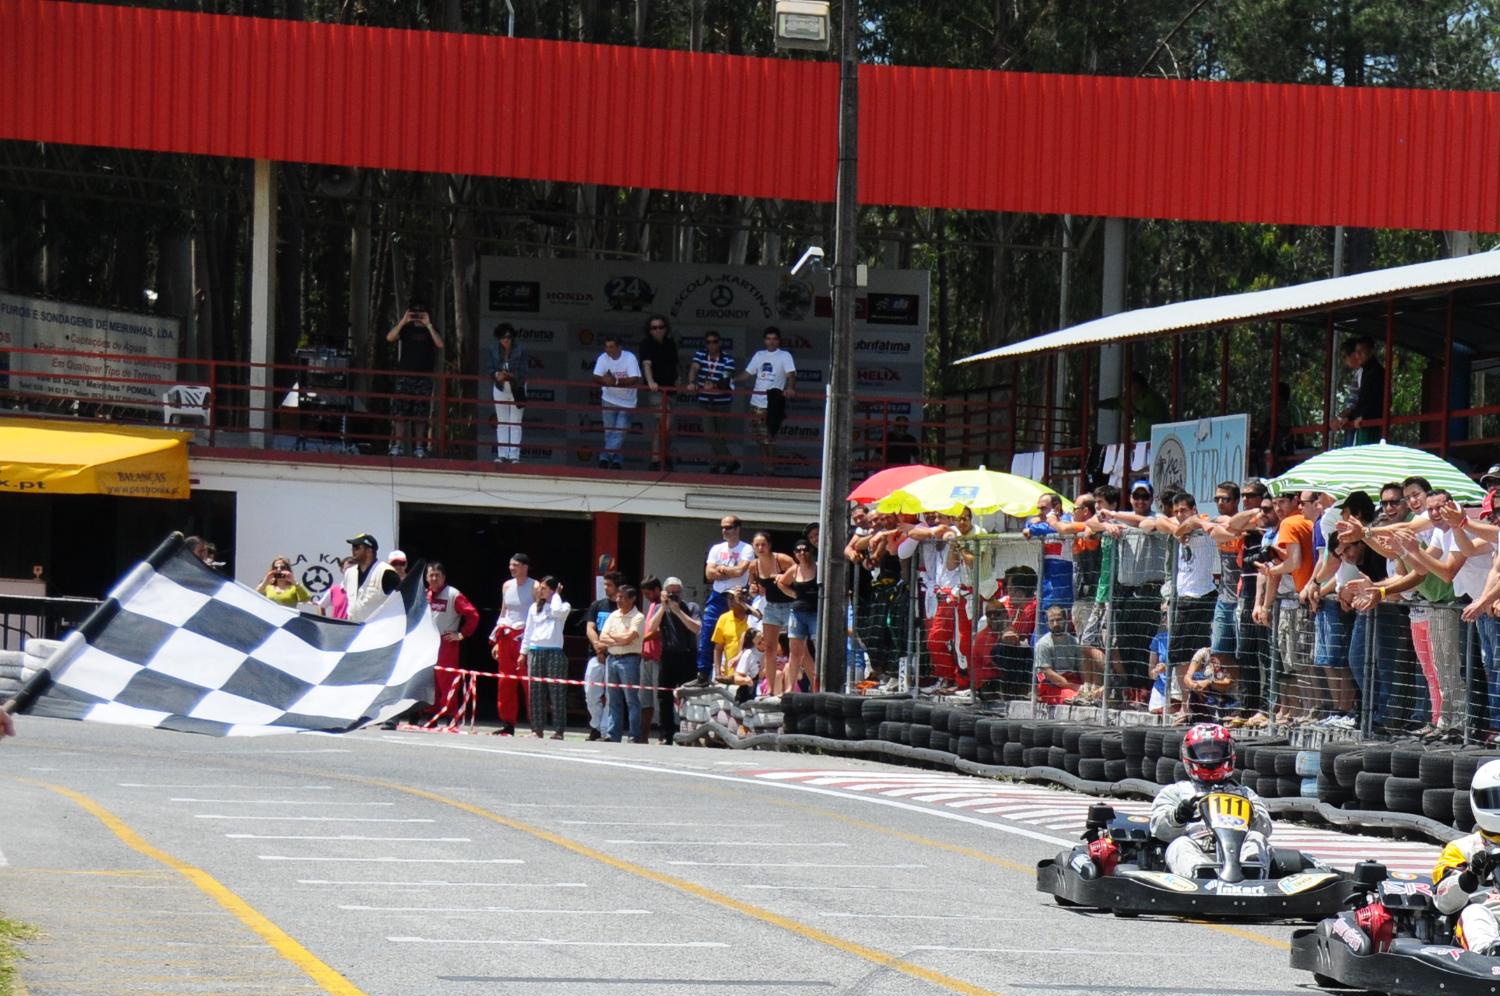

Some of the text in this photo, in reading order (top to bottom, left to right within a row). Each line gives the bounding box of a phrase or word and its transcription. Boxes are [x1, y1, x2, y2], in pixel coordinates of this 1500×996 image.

[546, 292, 593, 301] HONDA
[670, 273, 774, 319] ESCOLA KARTING
[41, 312, 94, 329] SONDAGENS
[95, 319, 108, 331] DE
[696, 308, 751, 319] EUROINDY
[857, 368, 900, 381] HELIX
[1213, 796, 1243, 816] 111
